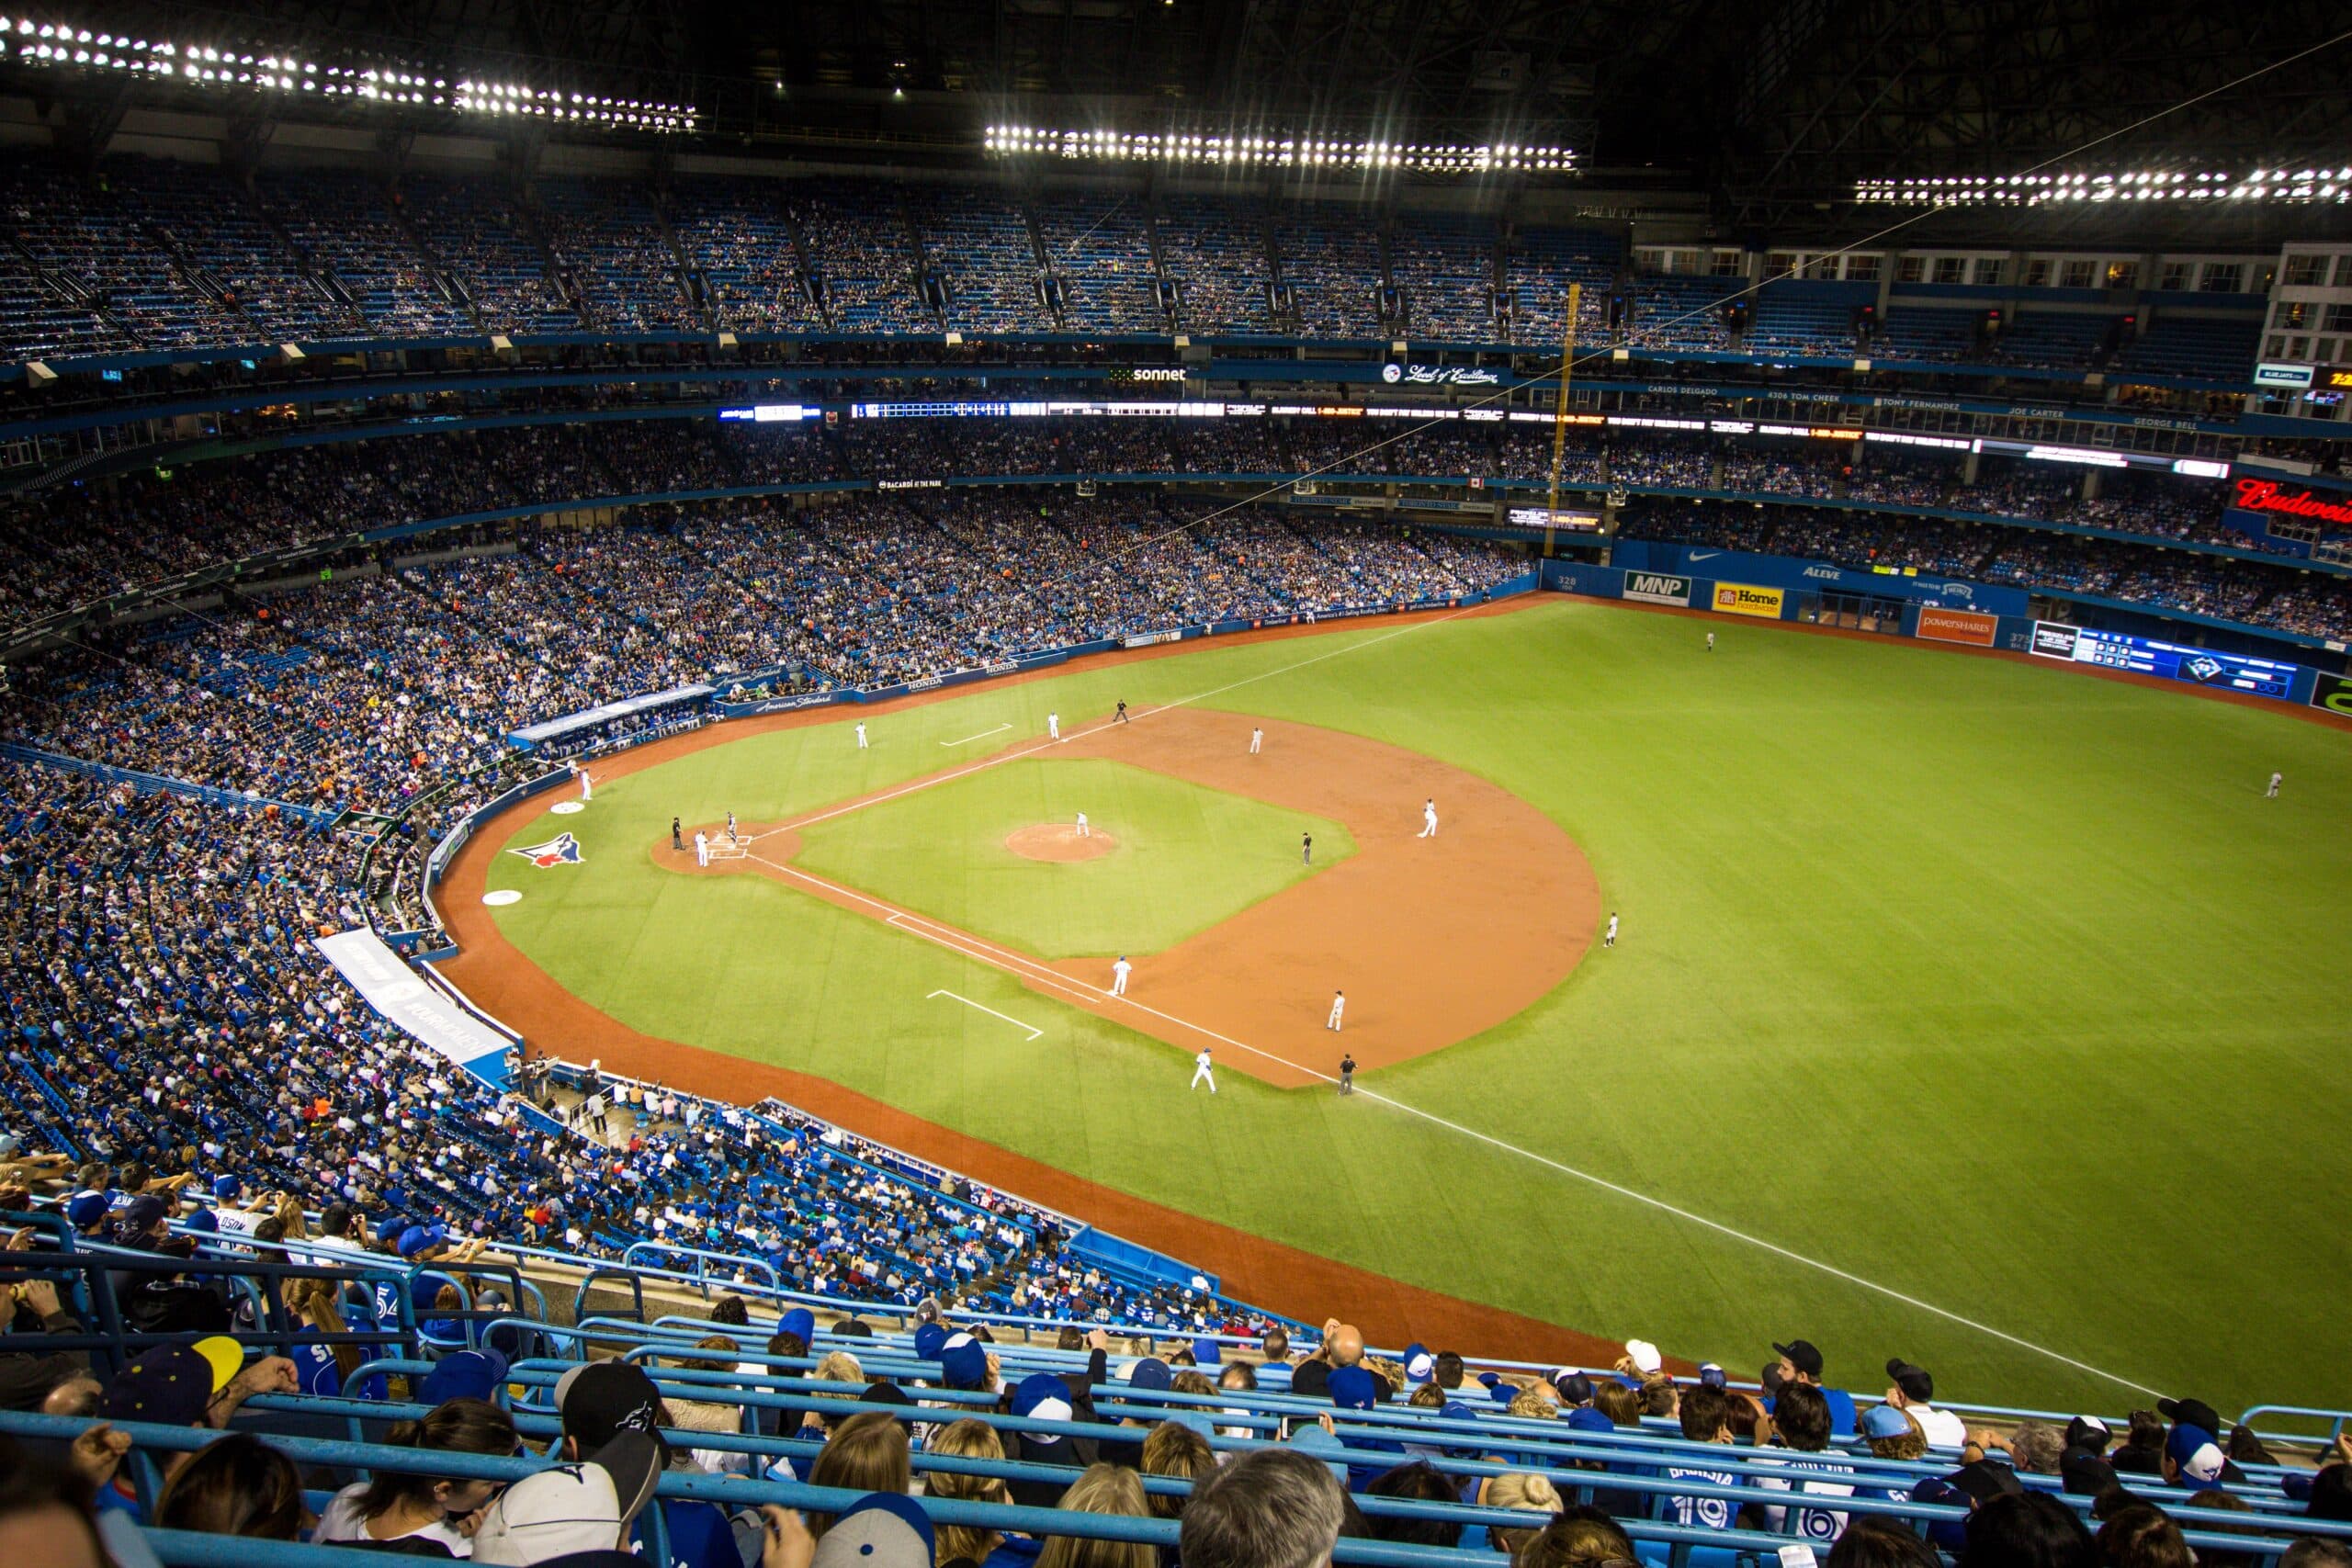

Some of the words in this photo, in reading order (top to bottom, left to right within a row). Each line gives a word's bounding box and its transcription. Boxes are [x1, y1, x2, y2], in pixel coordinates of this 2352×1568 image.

[1133, 368, 1186, 380] sonnet
[1405, 365, 1440, 382] Level
[1450, 367, 1498, 384] Excellence
[1648, 385, 1677, 394] CARLOS
[1681, 387, 1717, 396] DELGADO
[1792, 392, 1809, 401] TOM
[1813, 394, 1840, 402] CHEEK
[1883, 398, 1905, 407] TONY
[1909, 400, 1960, 411] FERNANDEZ
[2008, 407, 2028, 416] JOE
[2030, 409, 2064, 418] CARTER
[2134, 417, 2171, 428] GEORGE
[2176, 421, 2198, 430] BELL
[1803, 566, 1841, 581] ALEVE
[1558, 576, 1577, 585] 328
[1633, 575, 1682, 596] MNP
[1947, 587, 1967, 595] HEINZ
[1738, 590, 1779, 606] Home
[1737, 601, 1778, 613] hardware
[987, 662, 1018, 673] HONDA
[909, 679, 943, 690] HONDA
[756, 701, 797, 712] American
[797, 695, 831, 707] Standard
[1671, 1496, 1727, 1529] 19
